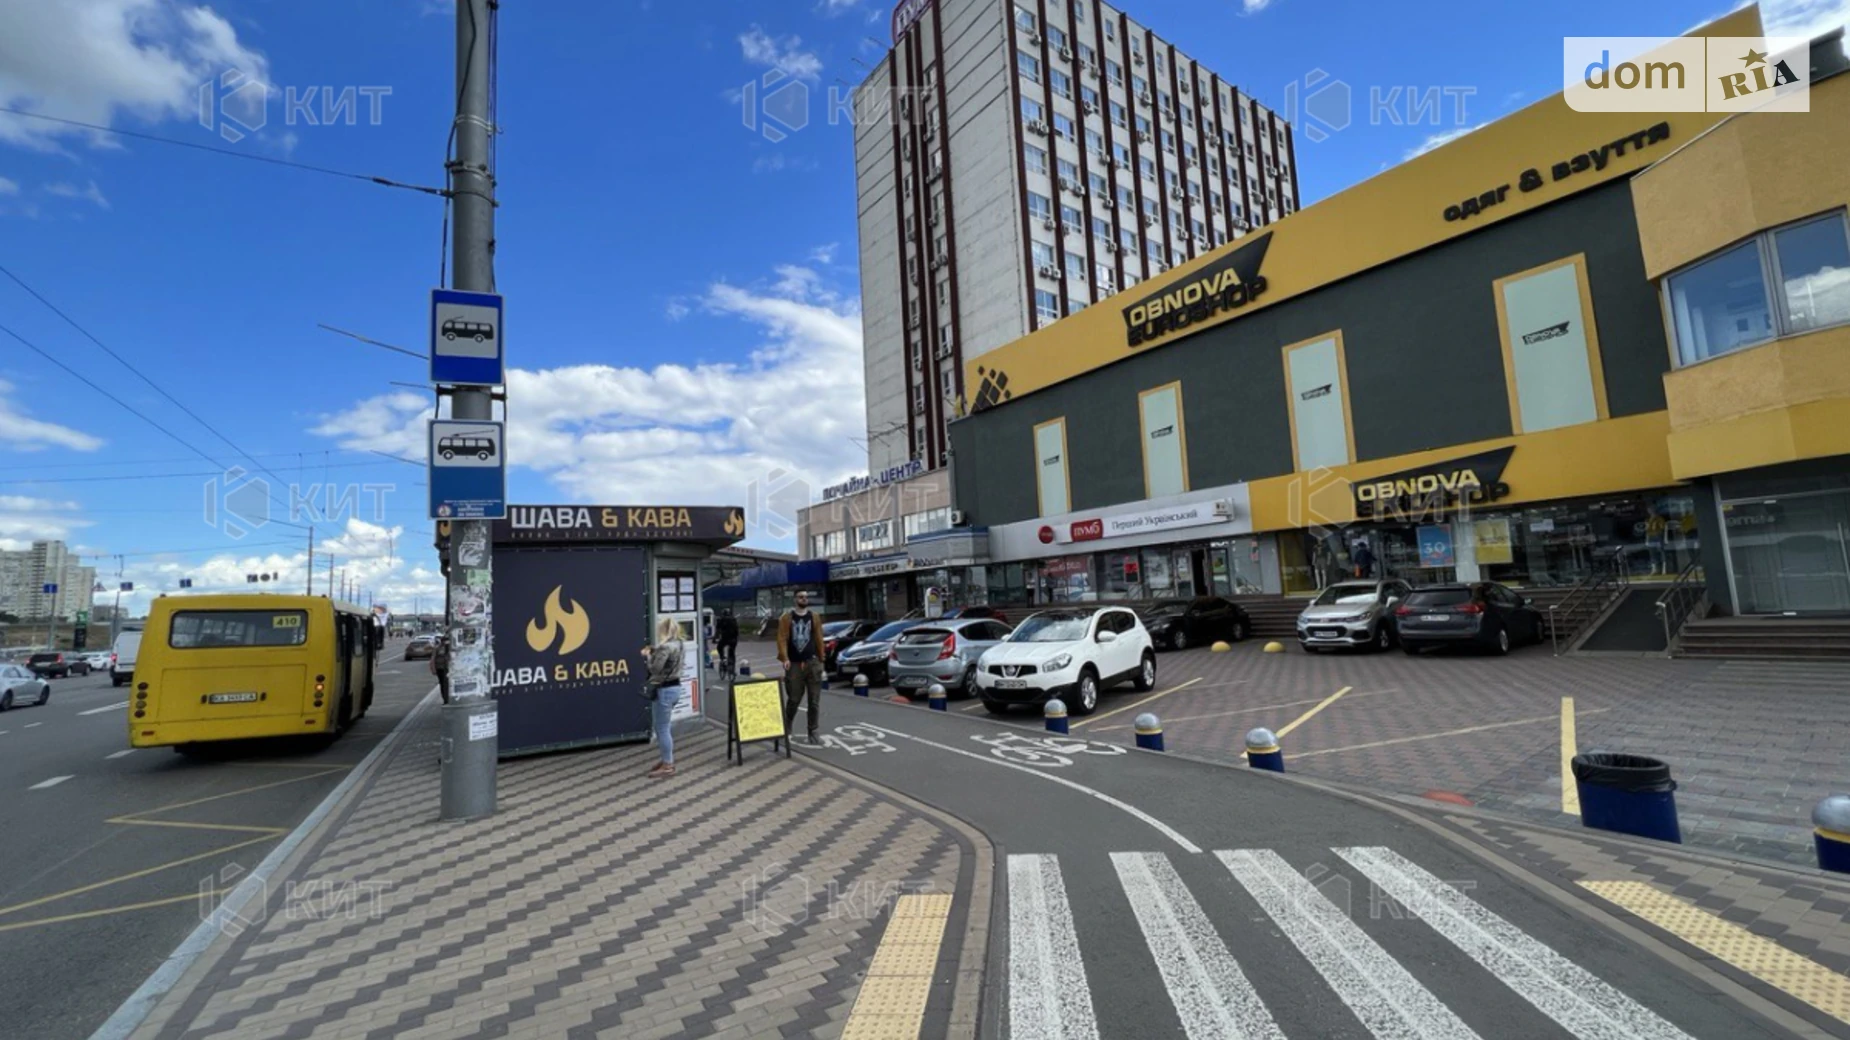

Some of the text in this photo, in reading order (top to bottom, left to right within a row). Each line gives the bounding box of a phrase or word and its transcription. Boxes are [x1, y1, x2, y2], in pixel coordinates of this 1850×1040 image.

[1443, 121, 1670, 221] одяг & взуття
[1127, 275, 1267, 347] EUROSHOP
[1130, 268, 1241, 327] OBNOVA
[880, 458, 923, 484] ЦЕНТР
[1358, 469, 1480, 501] OBNOVA
[511, 507, 692, 528] ШАВА & КАВА
[276, 617, 297, 626] 410
[554, 664, 569, 681] &
[576, 659, 629, 679] КАВА
